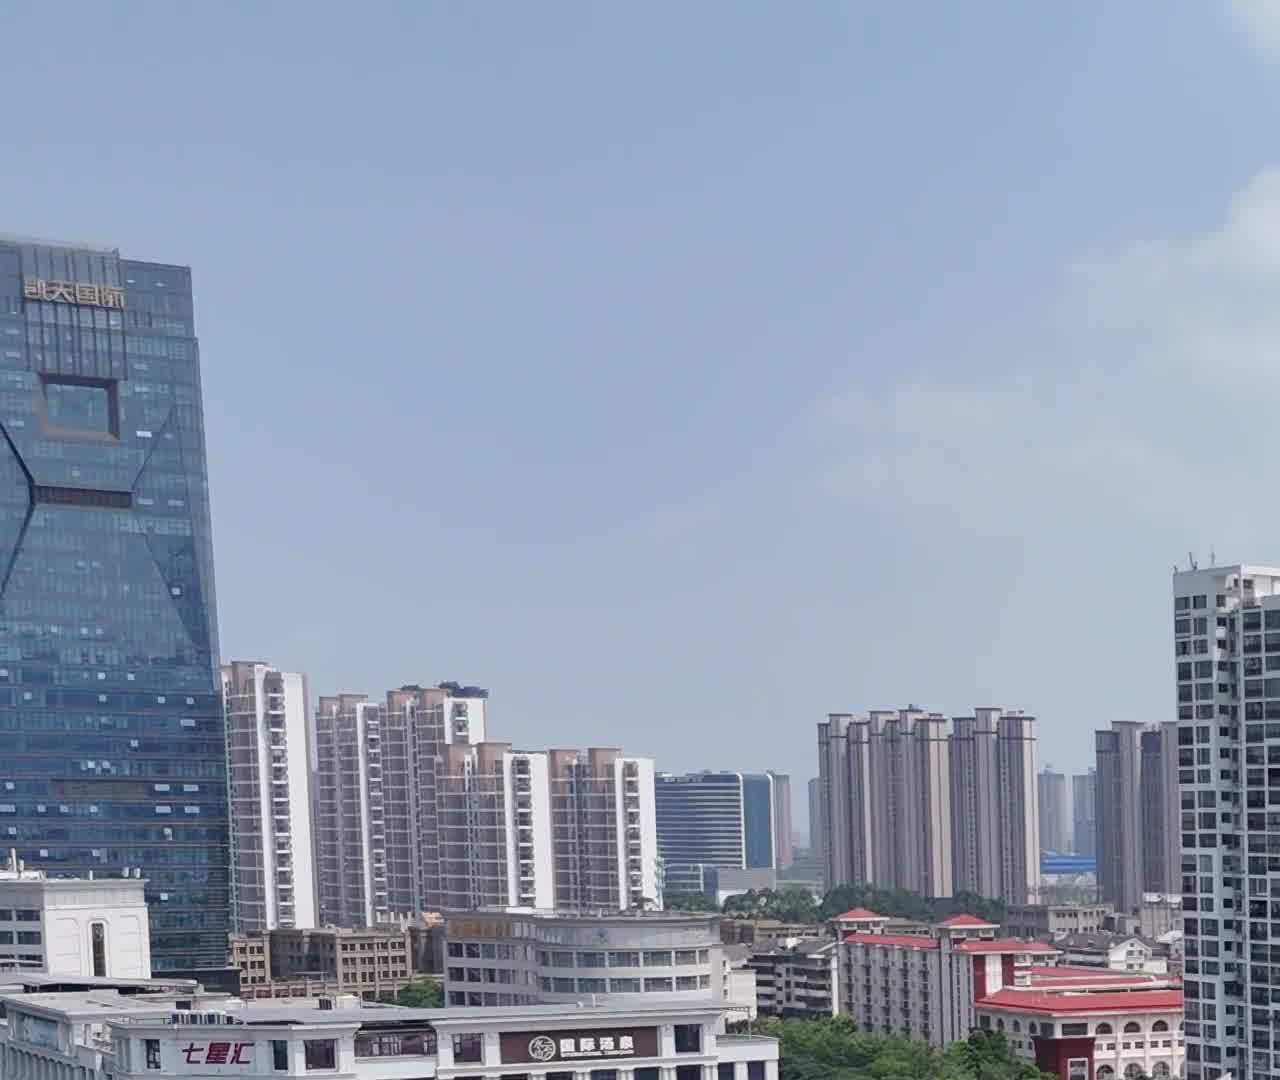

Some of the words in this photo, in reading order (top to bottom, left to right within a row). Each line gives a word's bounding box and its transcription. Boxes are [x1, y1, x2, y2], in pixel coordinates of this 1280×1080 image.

[23, 278, 127, 309] 凯天国际
[182, 1042, 254, 1065] 七星汇
